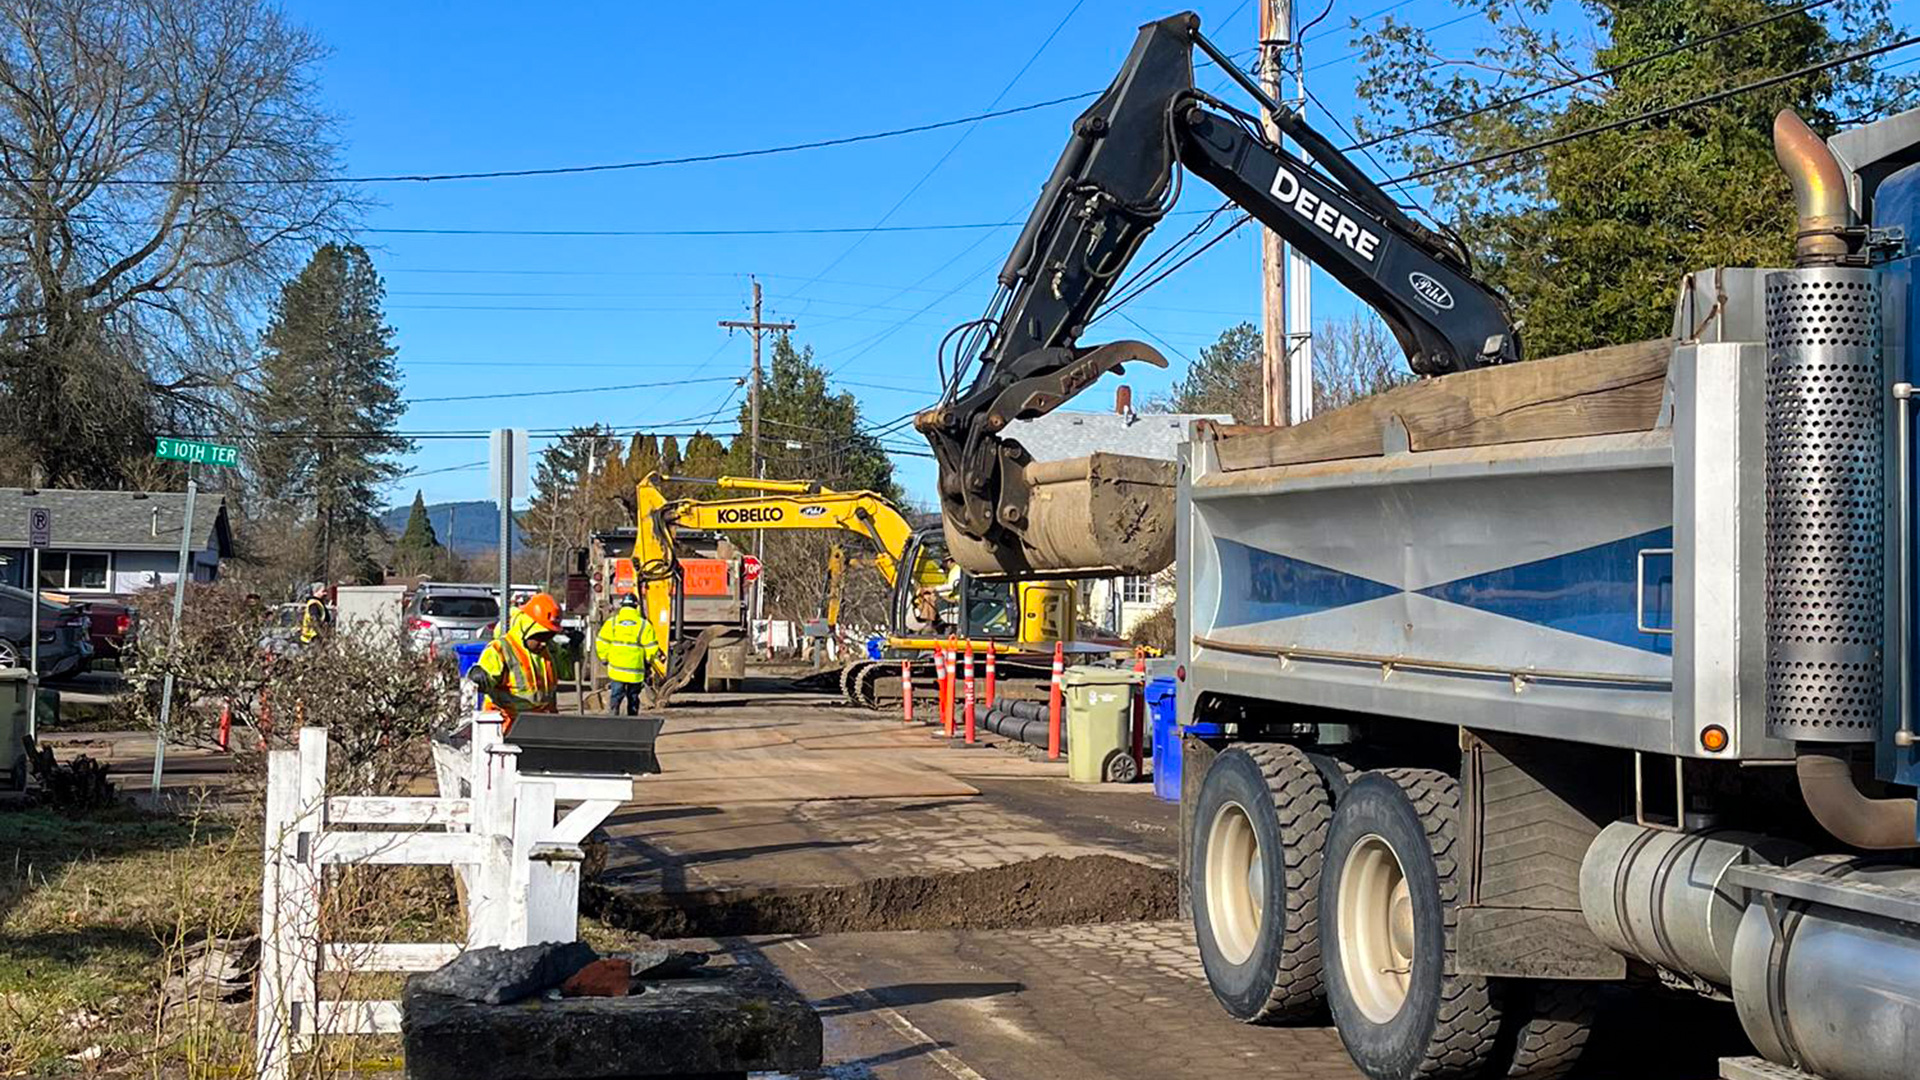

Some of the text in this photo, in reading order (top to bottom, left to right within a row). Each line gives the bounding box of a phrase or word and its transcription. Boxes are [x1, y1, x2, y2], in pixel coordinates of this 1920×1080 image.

[1270, 166, 1380, 261] DEERE
[158, 441, 236, 463] S 10TH TER
[717, 507, 783, 524] KOBELCO
[743, 563, 761, 574] TOP
